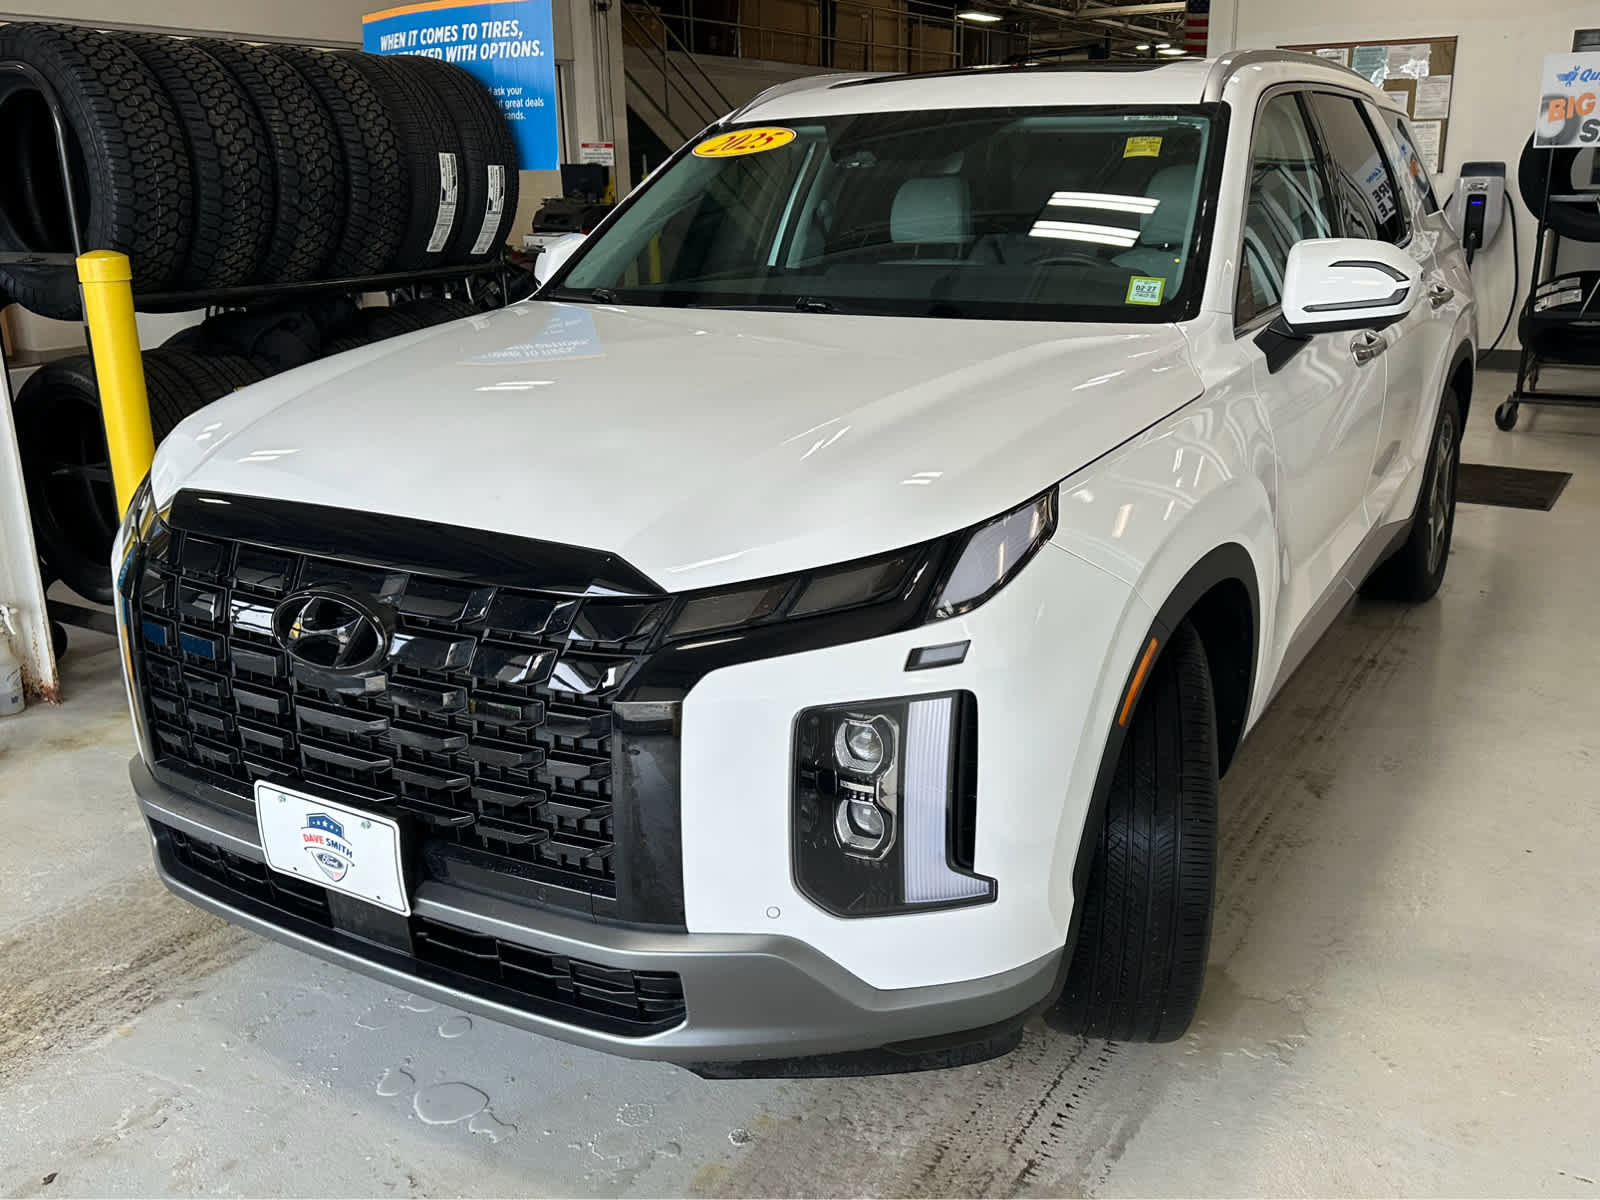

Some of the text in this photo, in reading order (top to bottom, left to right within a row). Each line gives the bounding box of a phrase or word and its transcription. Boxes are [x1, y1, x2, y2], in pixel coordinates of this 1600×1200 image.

[380, 19, 523, 52] WHEN IT COMES TO TIRES,
[446, 43, 477, 63] WITH
[480, 39, 545, 60] OPTIONS.
[493, 85, 506, 96] ask
[506, 87, 523, 97] your
[505, 98, 523, 110] great
[524, 96, 545, 108] deals
[1548, 92, 1597, 123] BIG
[302, 833, 353, 859] DAVE SMITH
